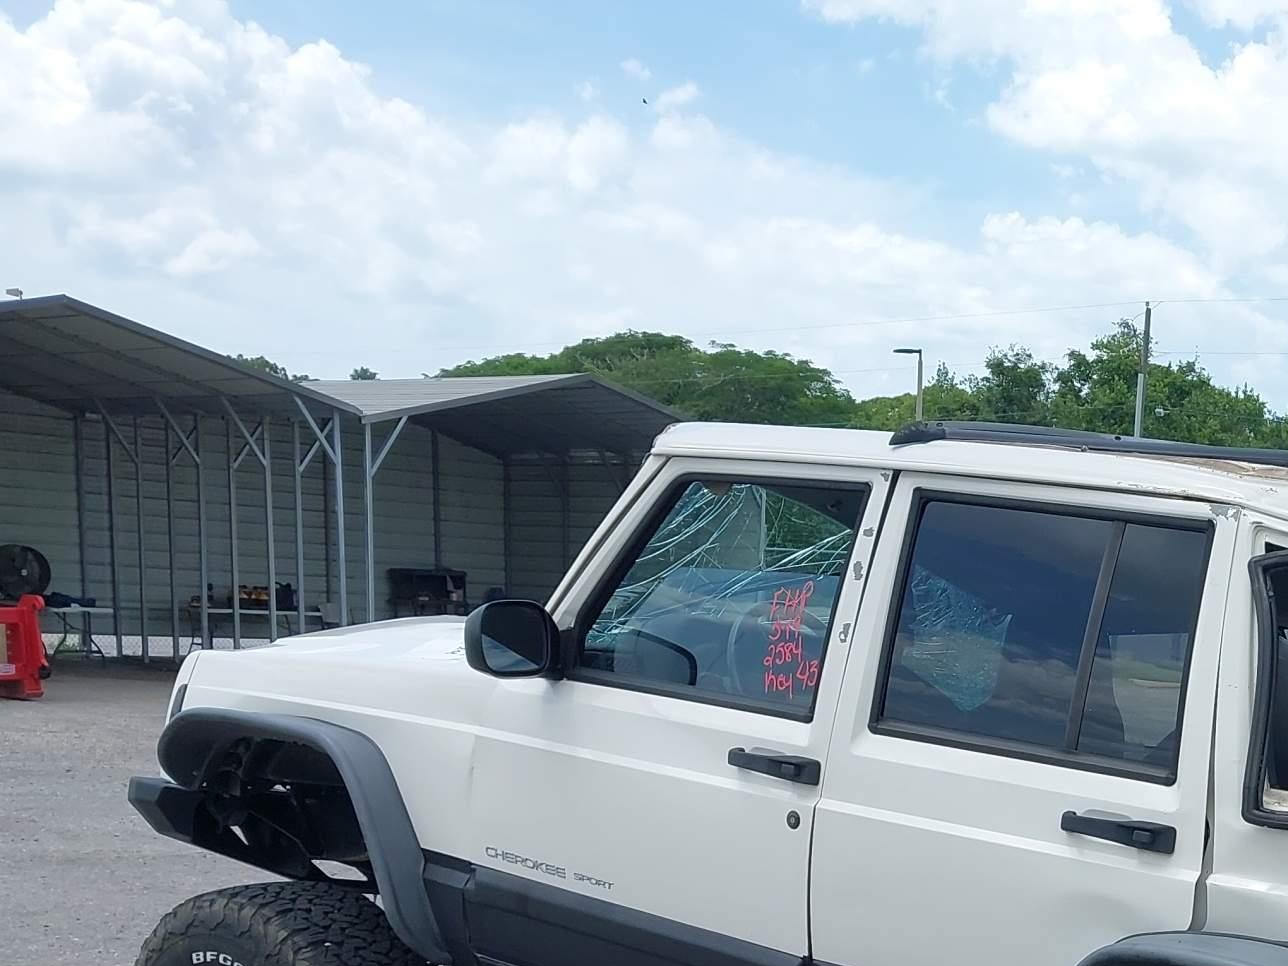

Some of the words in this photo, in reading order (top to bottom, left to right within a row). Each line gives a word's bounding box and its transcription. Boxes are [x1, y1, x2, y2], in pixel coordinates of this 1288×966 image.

[763, 636, 802, 667] 2584
[485, 846, 567, 879] CHEROKEE
[573, 872, 615, 889] SPORT
